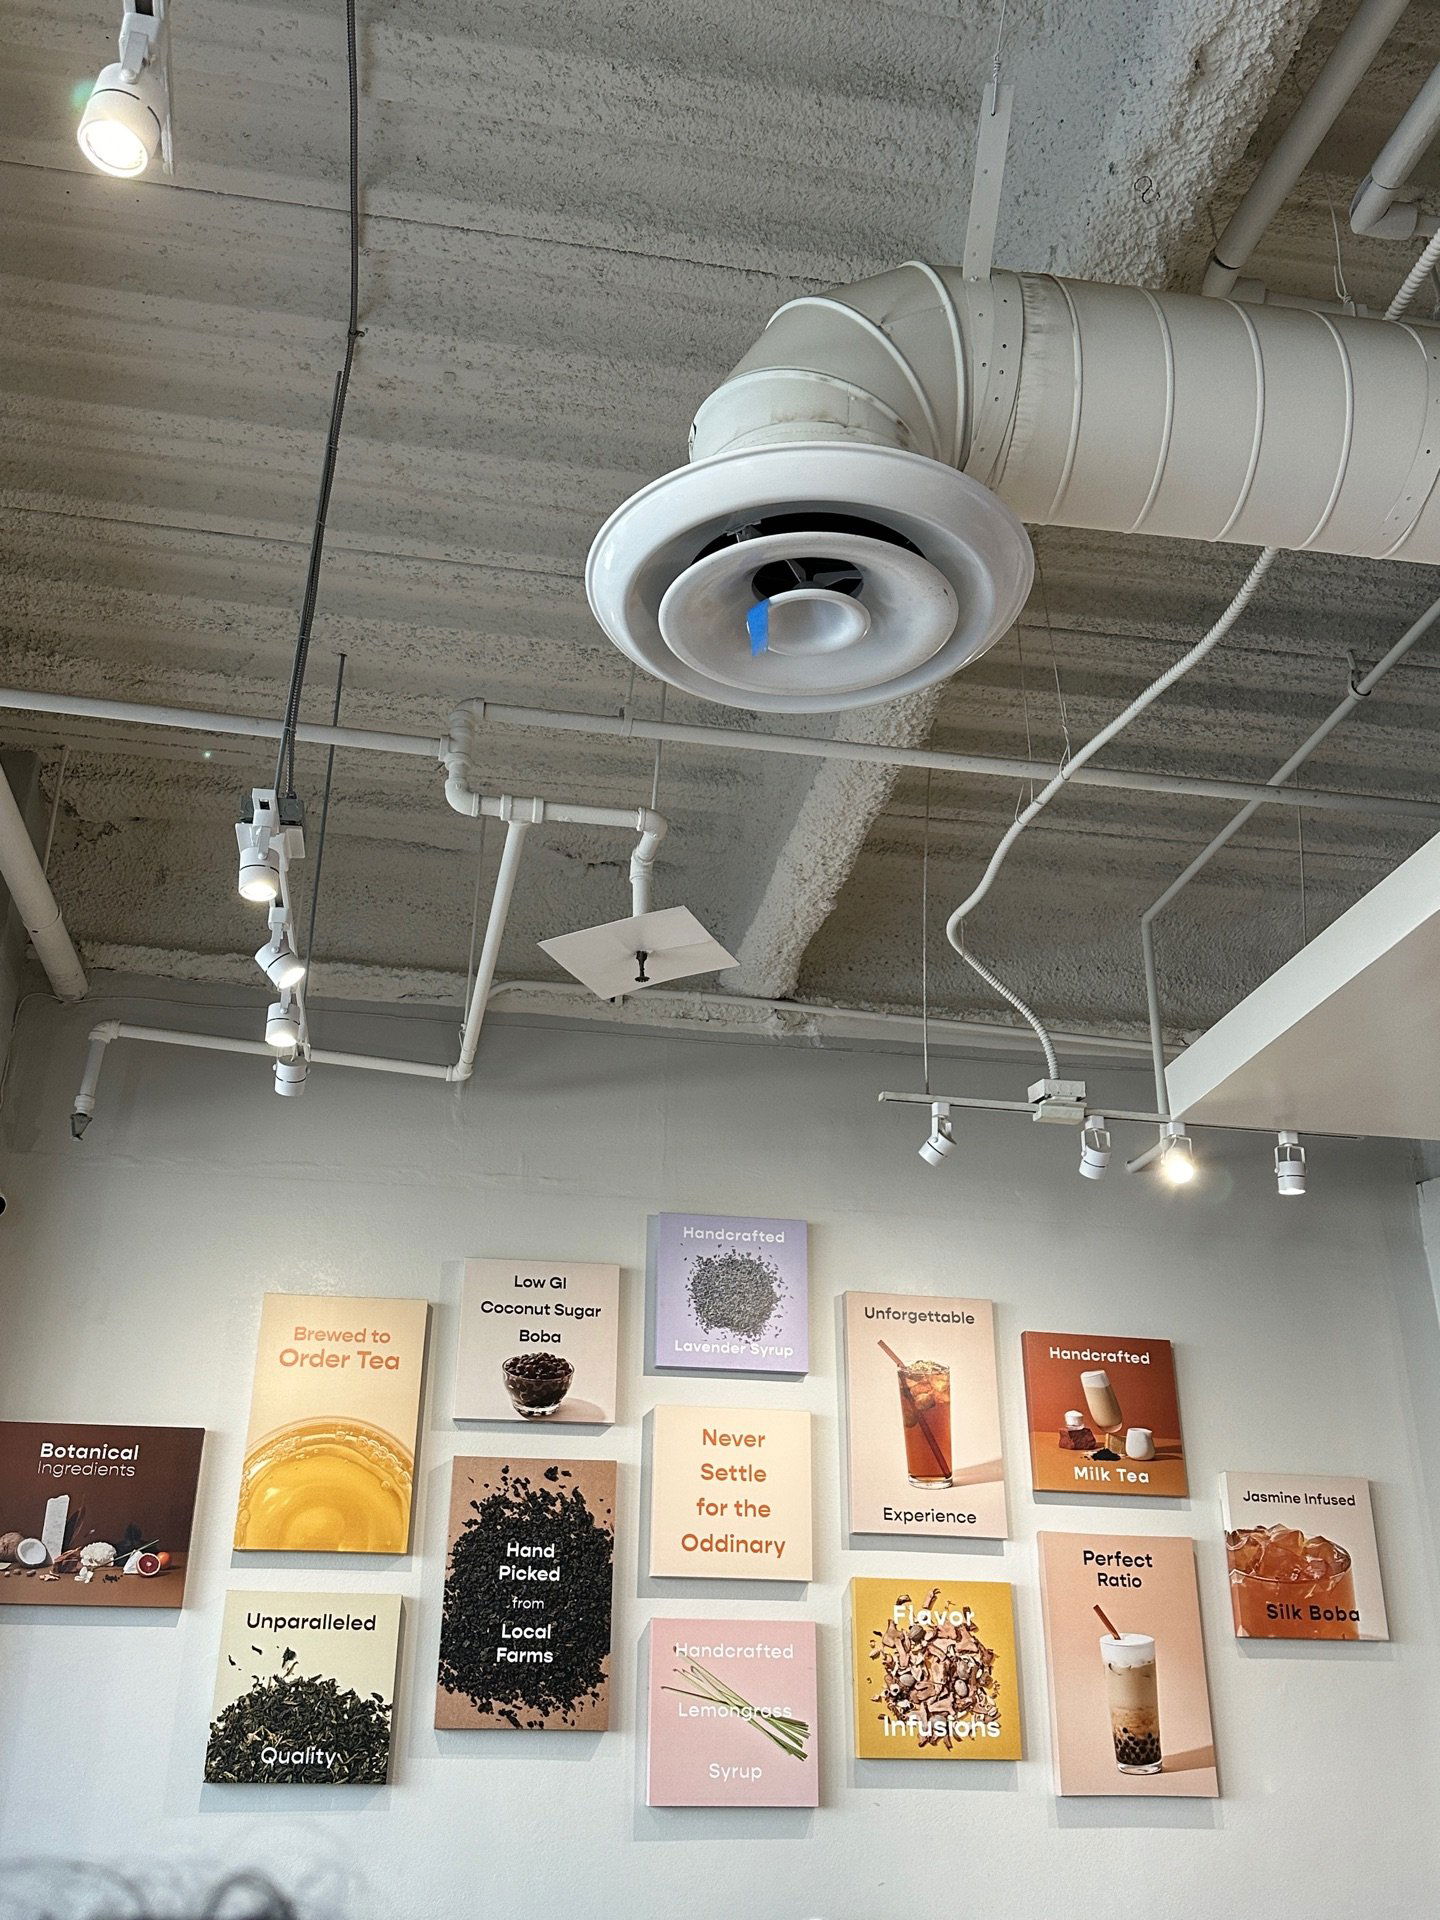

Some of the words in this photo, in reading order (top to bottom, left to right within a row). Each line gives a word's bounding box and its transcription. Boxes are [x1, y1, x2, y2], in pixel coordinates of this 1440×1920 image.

[683, 1226, 785, 1243] Handcrafted
[514, 1275, 545, 1290] Low
[549, 1276, 567, 1290] GI
[480, 1301, 550, 1316] Coconut
[554, 1303, 602, 1319] Sugar
[864, 1306, 975, 1326] Unforgettable
[293, 1326, 366, 1344] Brewed
[369, 1329, 391, 1344] to
[519, 1330, 561, 1345] Boba
[675, 1340, 746, 1355] Lavender
[750, 1343, 794, 1359] Syrup
[1049, 1347, 1150, 1365] Handcrafted
[279, 1348, 350, 1370] Order
[356, 1351, 400, 1371] Tea
[702, 1429, 766, 1448] Never
[39, 1442, 139, 1461] Botanical
[36, 1461, 136, 1479] Ingredients
[701, 1463, 767, 1482] Settle
[1073, 1467, 1111, 1483] Milk
[1116, 1467, 1149, 1484] Tea
[1243, 1490, 1300, 1506] Jasmine
[1304, 1492, 1356, 1507] Infused
[696, 1498, 729, 1517] for
[734, 1499, 771, 1518] the
[883, 1507, 977, 1525] Experience
[506, 1542, 555, 1559] Hand
[681, 1534, 786, 1558] Oddinary
[1082, 1550, 1153, 1569] Perfect
[498, 1565, 560, 1582] Picked
[1097, 1572, 1142, 1589] Ratio
[512, 1597, 544, 1610] from
[1266, 1603, 1302, 1620] Silk
[1308, 1605, 1360, 1622] Boba
[246, 1613, 376, 1634] Unparalleled
[892, 1605, 975, 1627] Flavor
[501, 1623, 551, 1639] Local
[496, 1647, 553, 1664] Farms
[675, 1642, 794, 1660] Handcrafted
[678, 1702, 792, 1721] Lemongrass
[883, 1717, 1000, 1738] Infusions
[260, 1747, 337, 1769] Quality
[709, 1762, 762, 1781] Syrup
